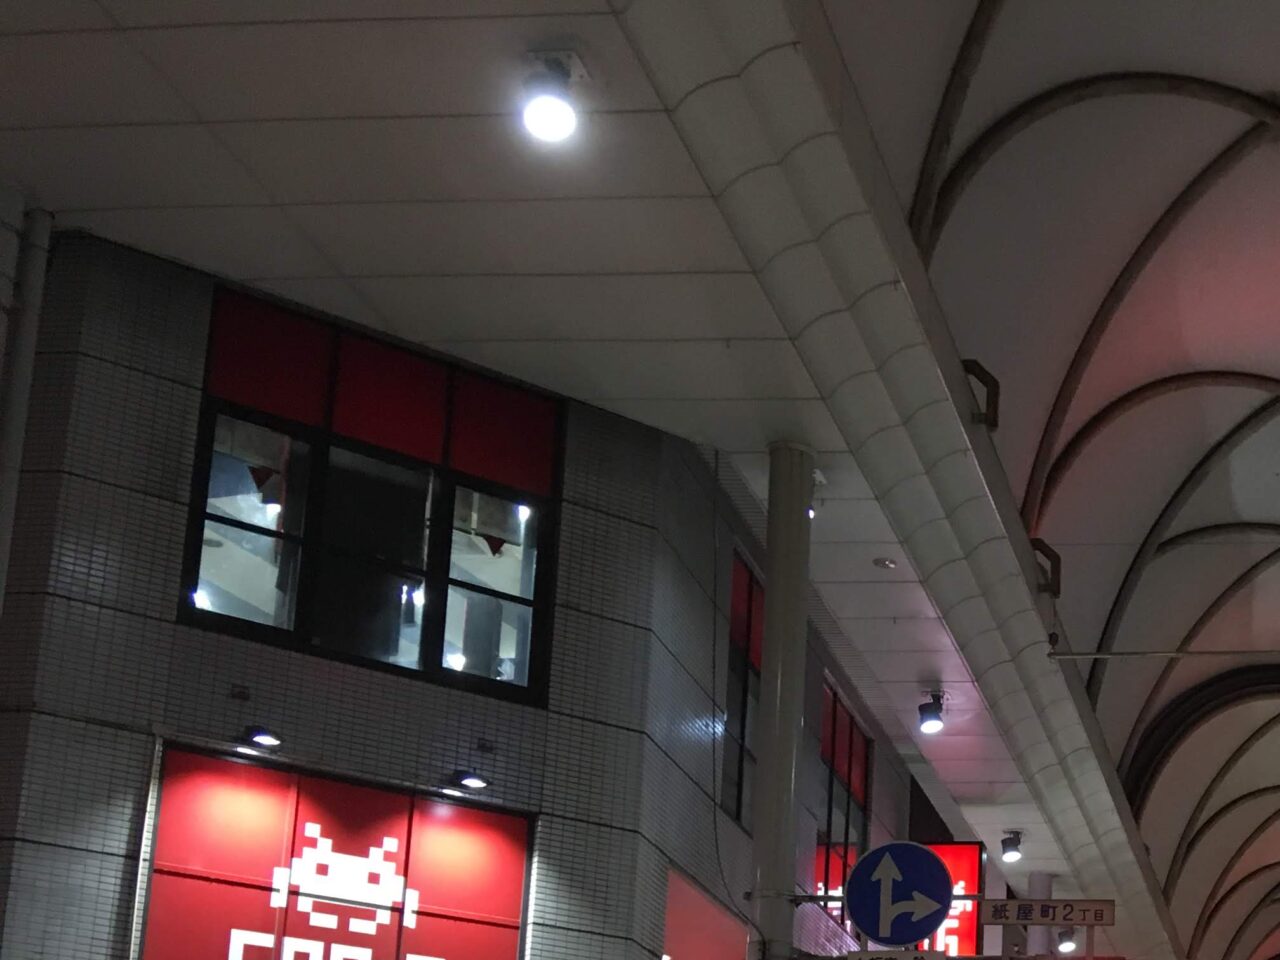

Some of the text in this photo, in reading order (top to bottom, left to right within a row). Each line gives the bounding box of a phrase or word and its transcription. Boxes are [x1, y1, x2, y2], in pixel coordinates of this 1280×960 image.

[992, 903, 1104, 922] 紙屋町2丁目
